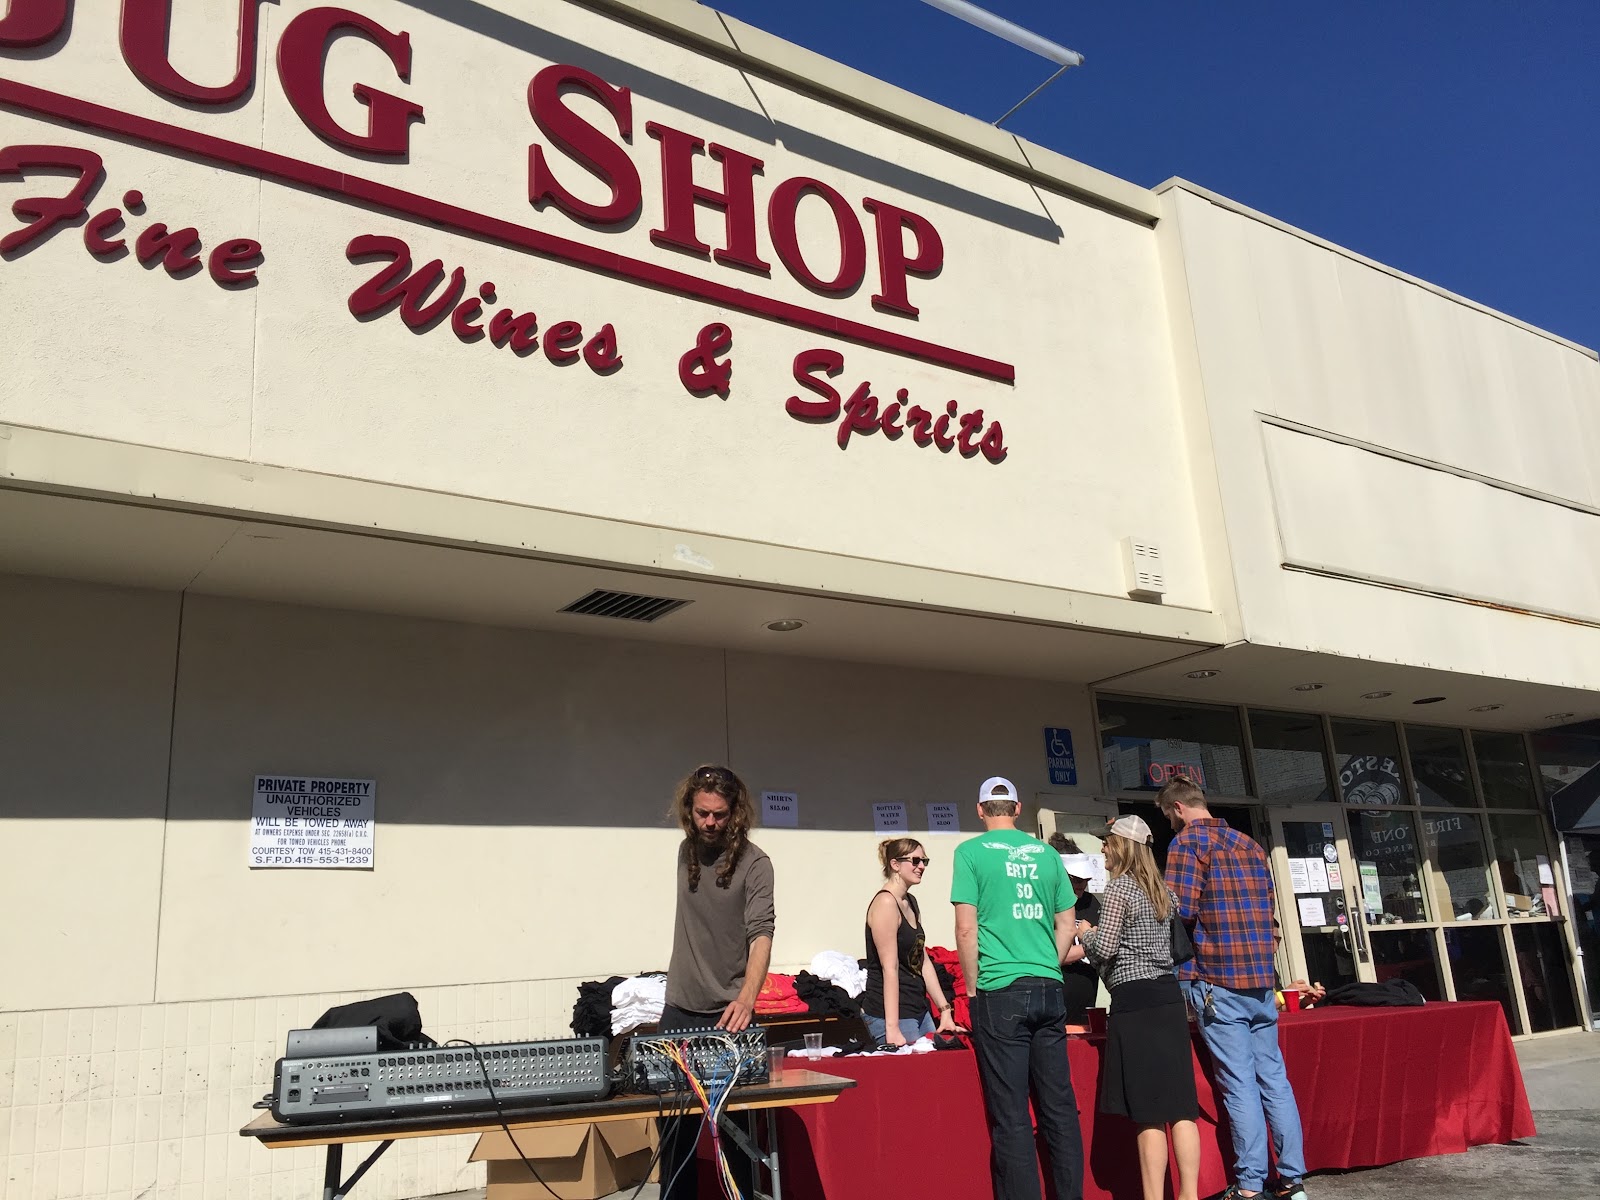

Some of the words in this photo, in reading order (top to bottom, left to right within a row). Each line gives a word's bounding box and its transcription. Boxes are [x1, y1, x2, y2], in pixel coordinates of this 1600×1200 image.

[0, 0, 424, 158] UG
[528, 64, 944, 317] SHOP
[0, 144, 263, 284] Fine
[346, 234, 623, 376] Wines
[679, 322, 733, 400] &
[786, 348, 1008, 462] Spirits
[1048, 757, 1075, 769] PARKING
[1054, 770, 1071, 782] ONLY
[1149, 762, 1203, 784] OPEN
[257, 778, 306, 792] PRIVATE
[310, 780, 370, 794] PROPERTY
[266, 794, 361, 806] UNAUTHORIZED
[287, 806, 341, 817] VEHICLES
[255, 816, 280, 827] WILL
[284, 817, 299, 827] BE
[303, 817, 339, 828] TOWED
[343, 818, 369, 829] AWAY
[254, 828, 261, 836] AT
[262, 828, 282, 836] OWNERS
[283, 828, 304, 837] EXPENSE
[305, 829, 320, 837] UNDER
[277, 837, 287, 846] FOR
[289, 838, 306, 846] TOWED
[307, 838, 330, 846] VEHICLES
[331, 838, 347, 846] PHONE
[252, 846, 296, 855] COURTESY
[298, 847, 316, 855] TOW
[318, 847, 373, 855] 415-431-8400
[1005, 861, 1039, 880] ERTZ
[1016, 882, 1033, 899] SO
